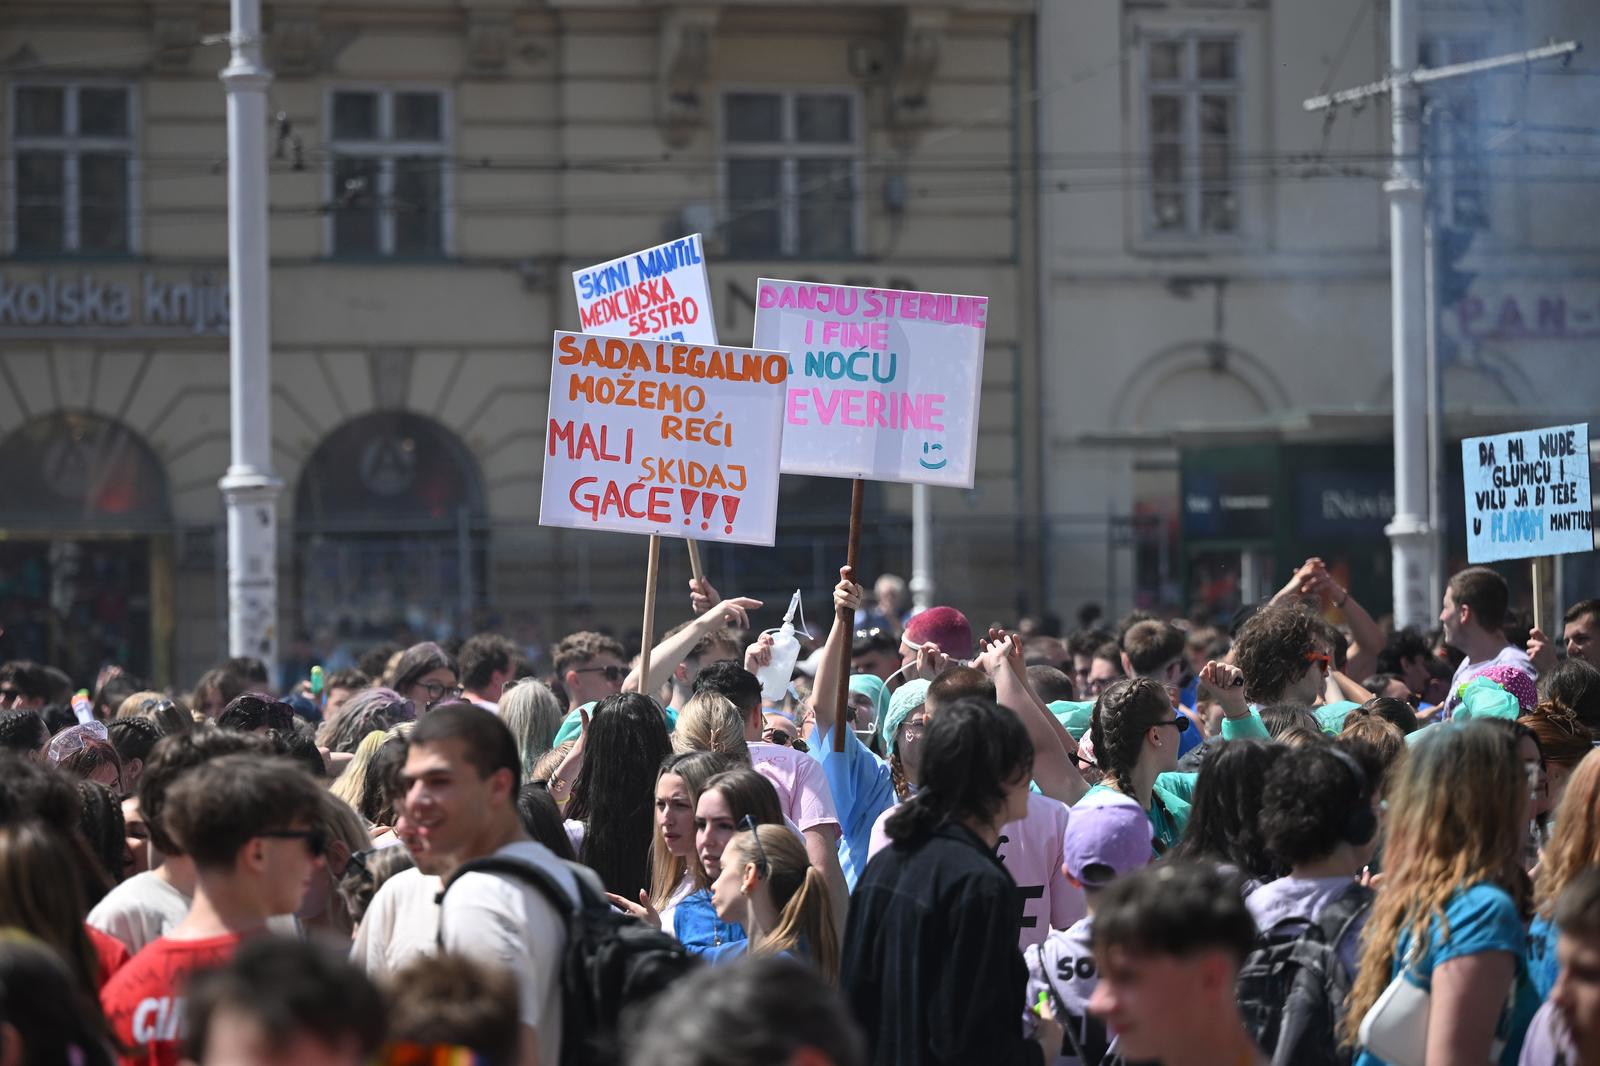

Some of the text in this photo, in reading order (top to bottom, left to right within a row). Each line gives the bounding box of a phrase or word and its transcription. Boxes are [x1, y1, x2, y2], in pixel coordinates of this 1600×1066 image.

[578, 261, 630, 299] SKINI
[580, 276, 675, 329] MEDICINSKA
[628, 296, 699, 337] SESTRO
[759, 285, 859, 316] DANJU
[863, 289, 987, 329] STERILNE
[804, 319, 890, 350] I FINE
[558, 335, 788, 385] SADA LEGALNO
[804, 345, 897, 384] NOĆU
[569, 373, 706, 413] MOŽEMO
[786, 387, 946, 432] EVERINE
[549, 418, 634, 464] MALI
[661, 411, 733, 448] REĆI
[1478, 430, 1576, 467] DA MI NUDE
[640, 457, 748, 491] SKIDAJ
[1492, 458, 1565, 489] GLUMICU I
[1475, 481, 1578, 511] VILU JA BI TEBE
[1473, 517, 1482, 536] U
[1490, 508, 1545, 543] PLAVOM
